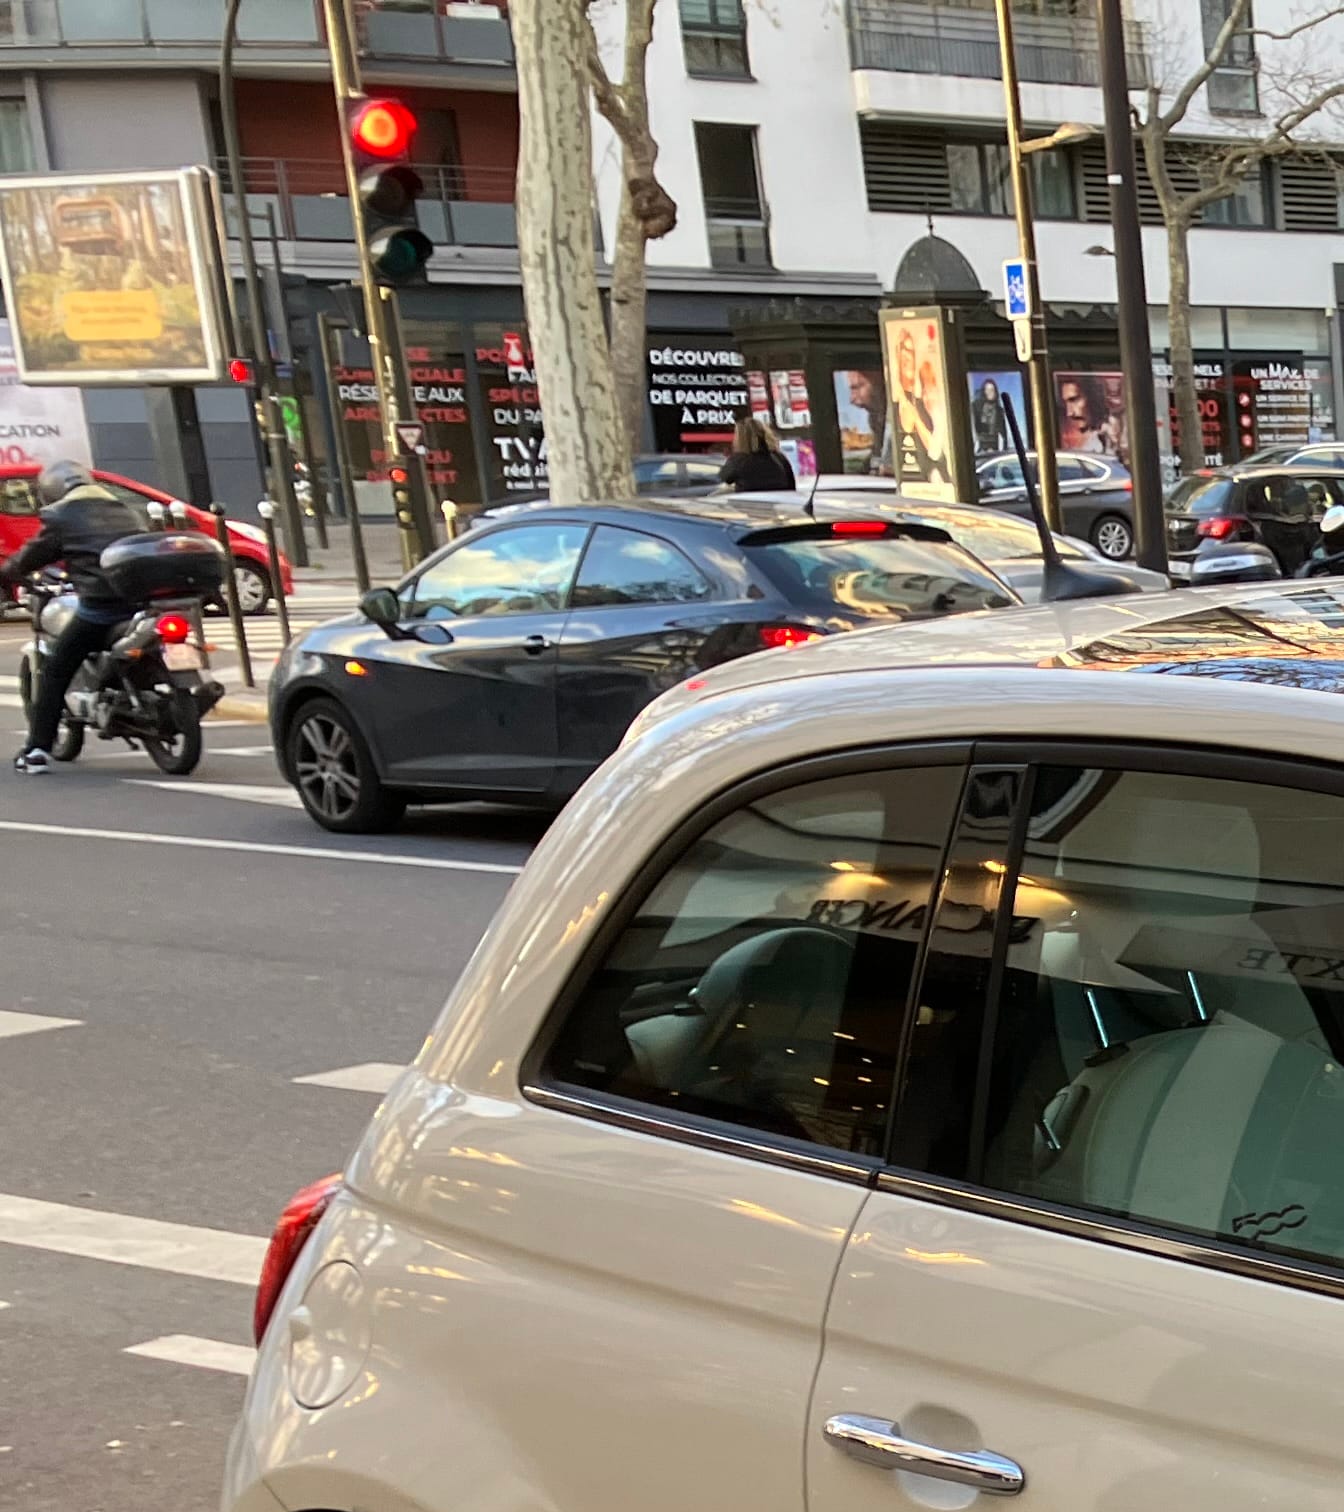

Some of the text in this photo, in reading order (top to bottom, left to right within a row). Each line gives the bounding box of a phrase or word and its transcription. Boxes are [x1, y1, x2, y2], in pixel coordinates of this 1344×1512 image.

[649, 389, 748, 407] DE PARQUET
[681, 405, 735, 425] À PRIX
